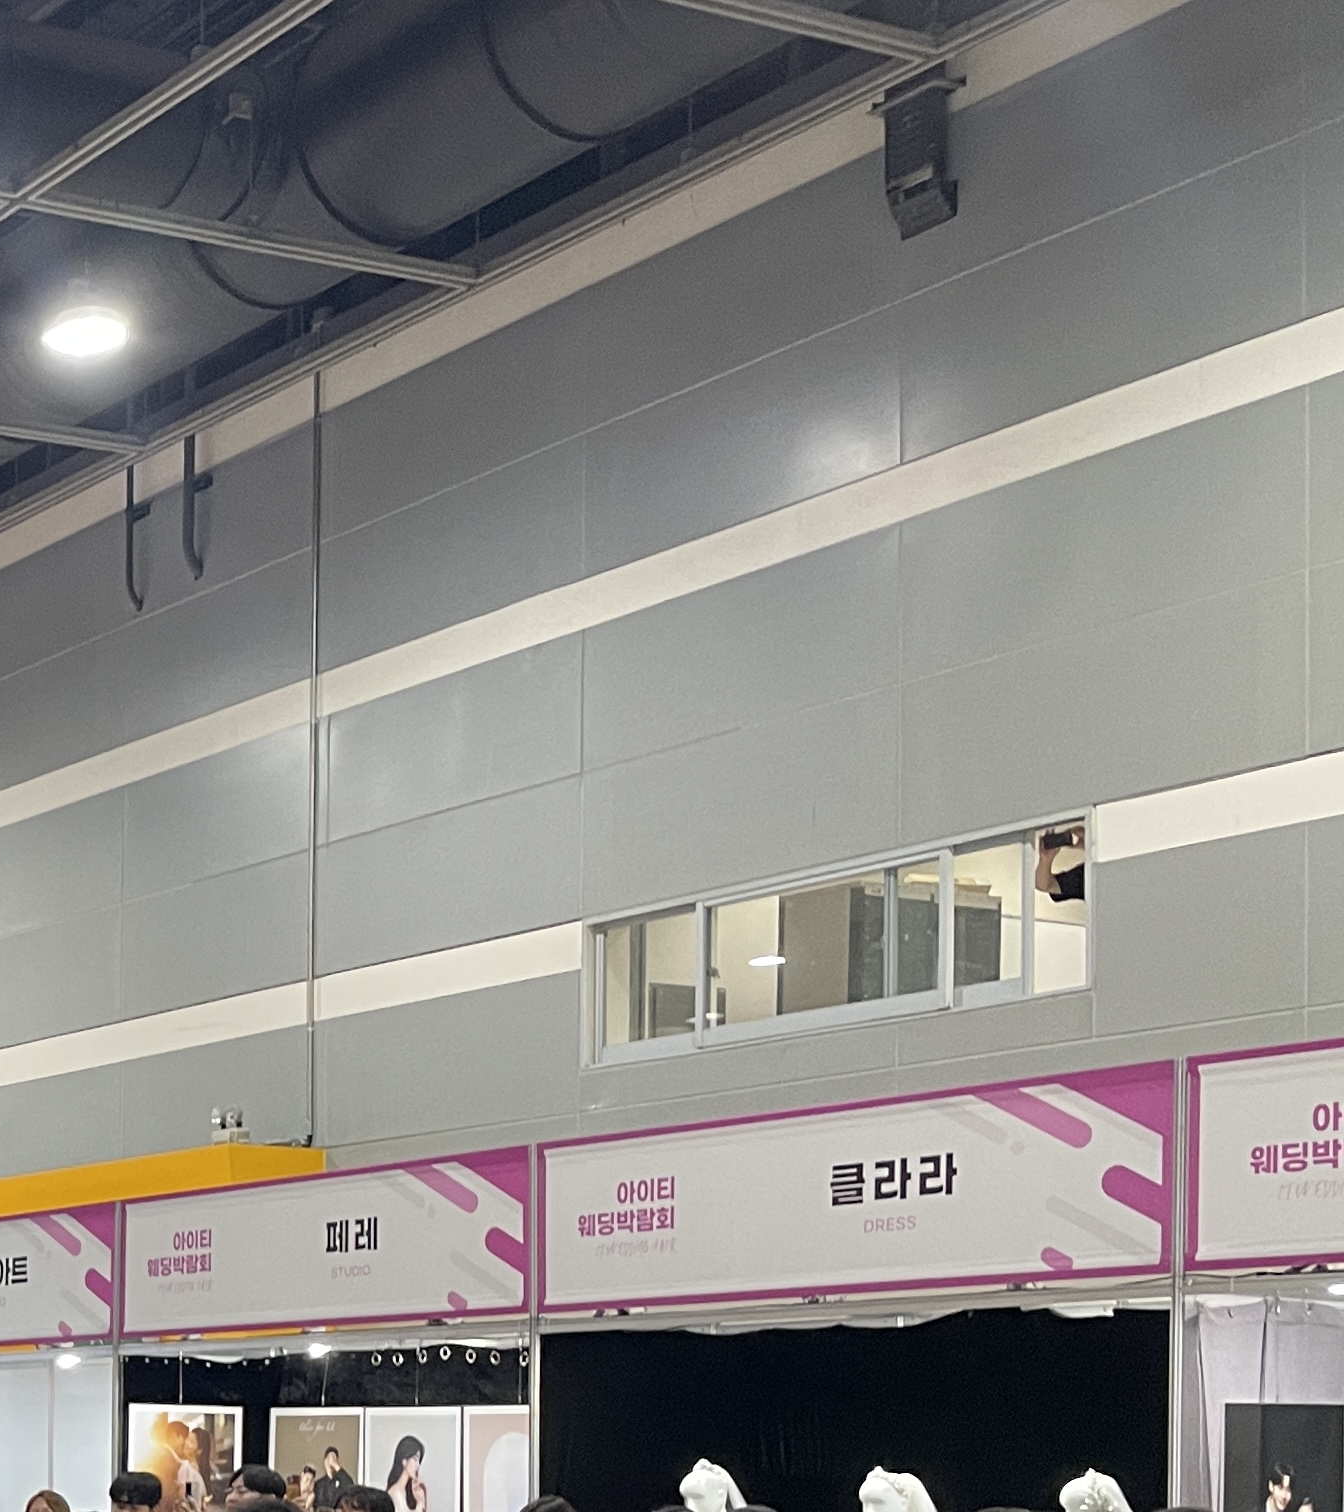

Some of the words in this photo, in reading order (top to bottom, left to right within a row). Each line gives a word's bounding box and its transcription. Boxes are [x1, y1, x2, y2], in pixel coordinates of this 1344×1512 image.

[1312, 1101, 1343, 1131] 아
[1250, 1139, 1343, 1174] 웨딩박
[616, 1176, 676, 1204] 아이티
[830, 1152, 958, 1206] 클라라
[578, 1206, 676, 1238] 웨딩박람회
[863, 1215, 917, 1234] DRESS
[173, 1229, 212, 1251] 아이티
[147, 1253, 212, 1277] 웨딩박람회
